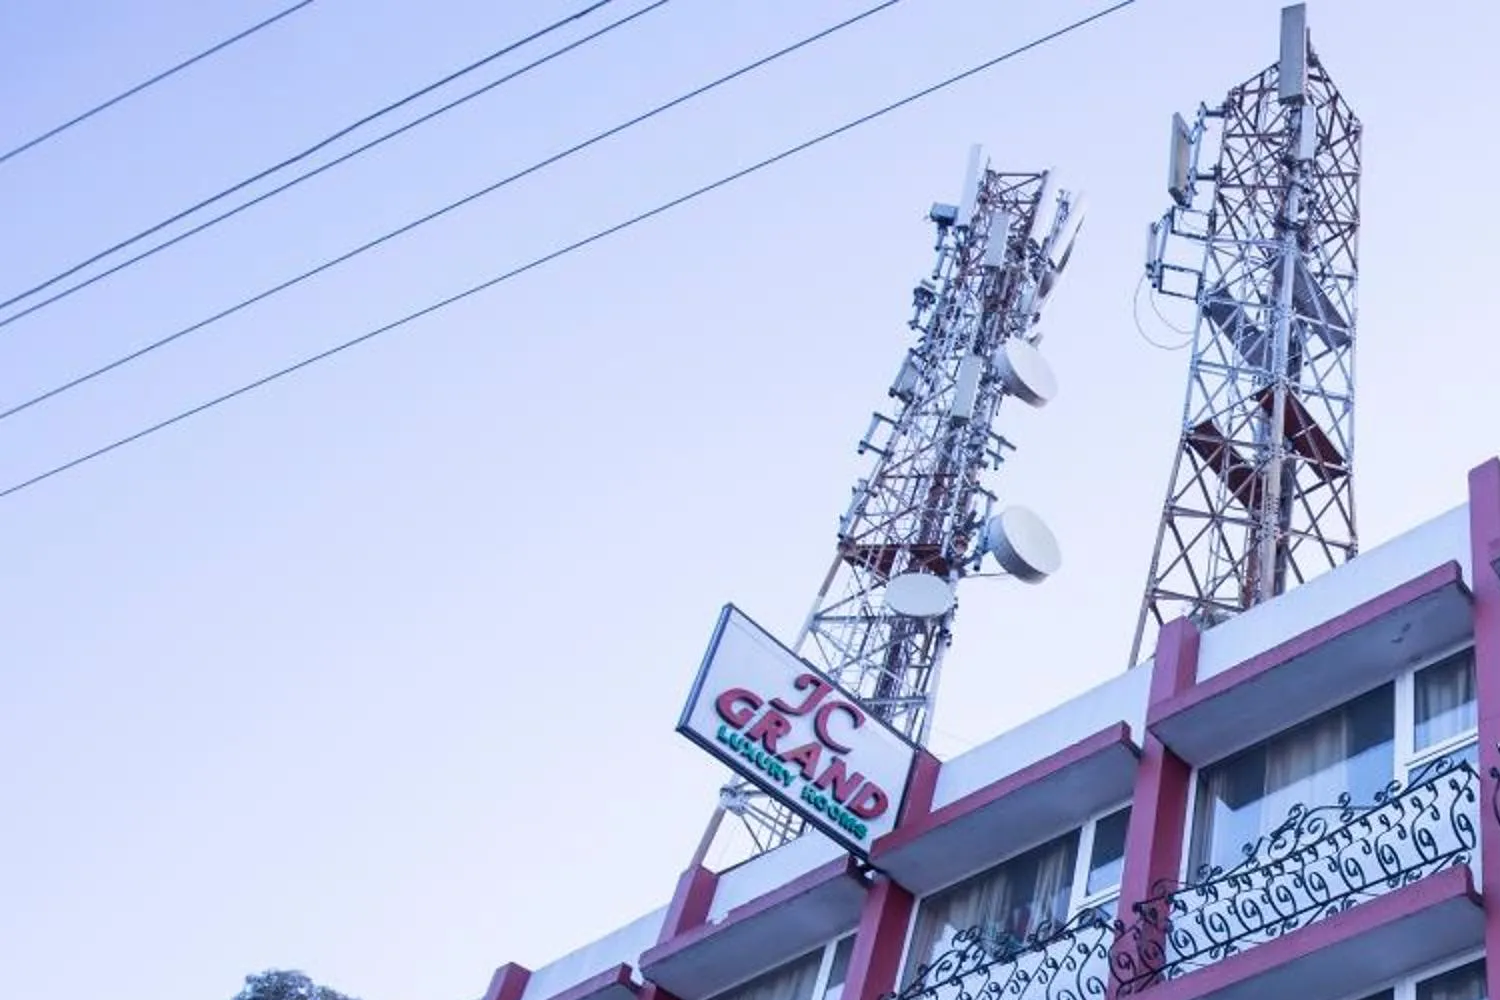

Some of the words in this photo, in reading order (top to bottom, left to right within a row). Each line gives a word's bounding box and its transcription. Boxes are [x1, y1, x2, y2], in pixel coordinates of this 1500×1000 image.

[715, 687, 889, 820] GRAND
[768, 672, 866, 756] JC
[716, 725, 798, 788] LUXURY
[800, 784, 869, 840] ROOMS
